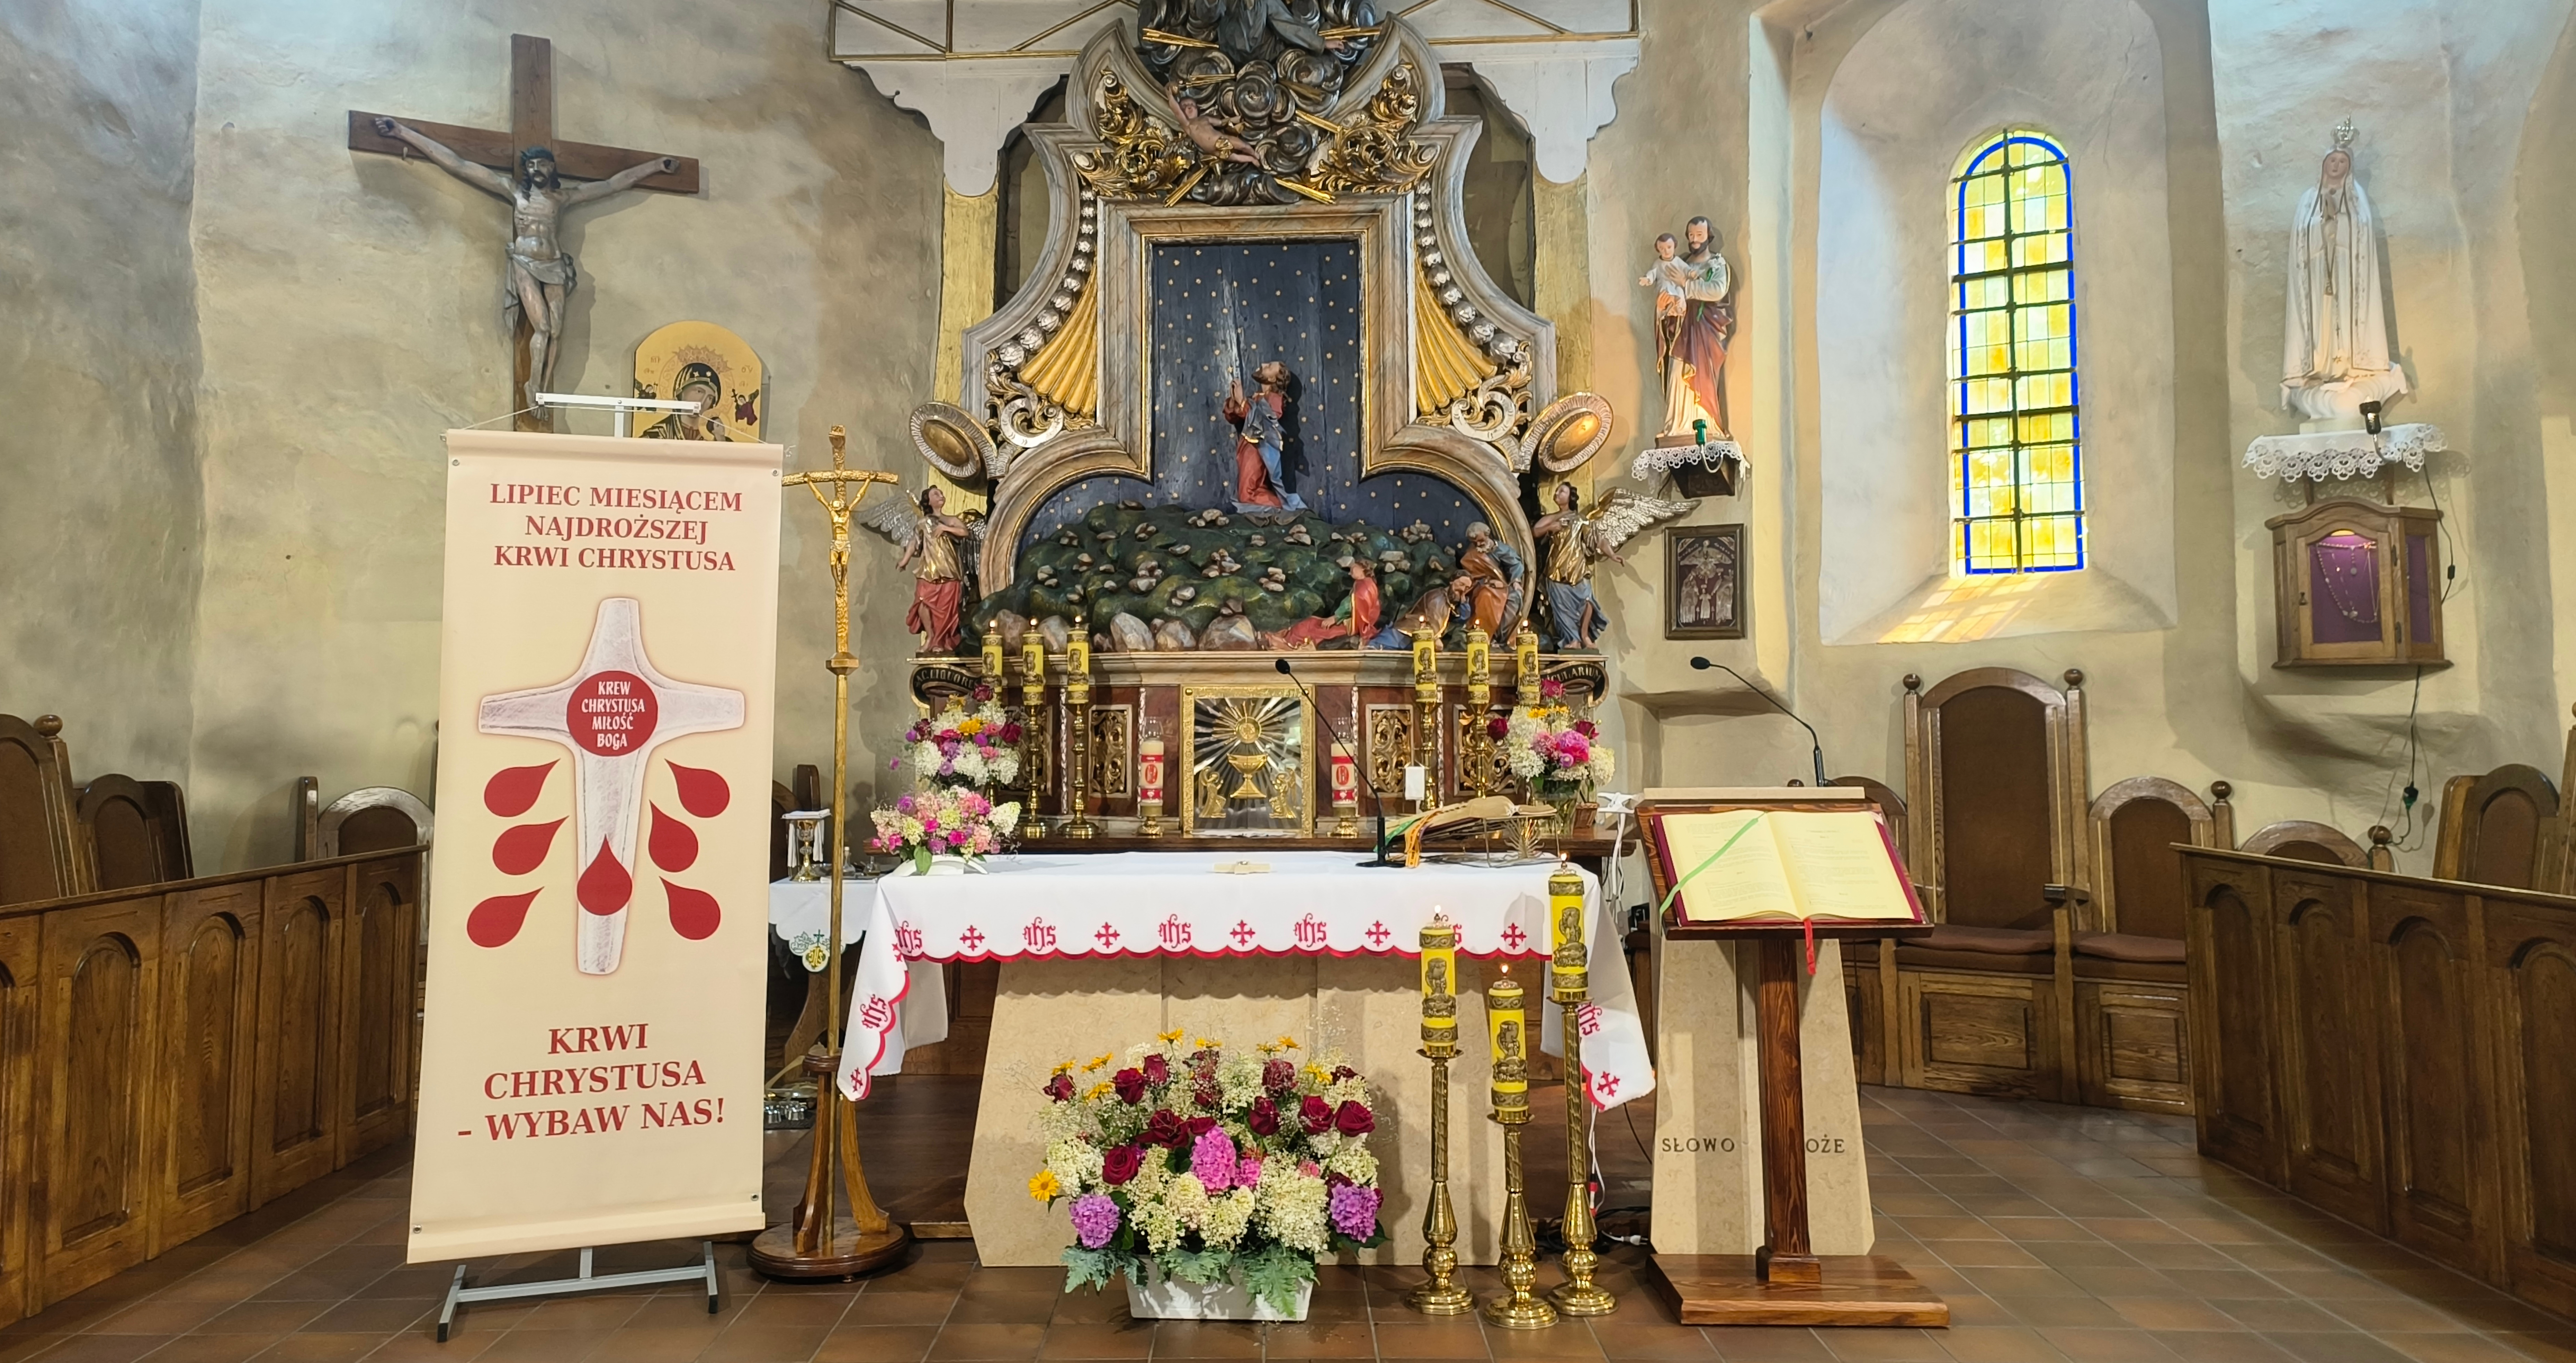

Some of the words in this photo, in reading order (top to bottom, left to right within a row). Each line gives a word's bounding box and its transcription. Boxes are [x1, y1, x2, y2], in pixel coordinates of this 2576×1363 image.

[490, 483, 581, 507] LIPIEC
[589, 486, 743, 515] MIESIĄCEM
[525, 514, 709, 545] NAJDROŻSZEJ
[494, 545, 570, 568] KRWI
[578, 547, 736, 571] CHRYSTUSA
[598, 681, 631, 696] KREW
[581, 698, 645, 713] CHRYSTUSA
[592, 712, 634, 730] MIŁOŚĆ
[597, 733, 628, 750] BOGA
[548, 1023, 649, 1054] KRWI
[484, 1060, 706, 1099] CHRYSTUSA
[485, 1105, 630, 1141] WYBAW
[641, 1098, 724, 1129] NAS!
[1662, 1137, 1735, 1152] SŁOWO
[1806, 1134, 1845, 1153] OŻE
